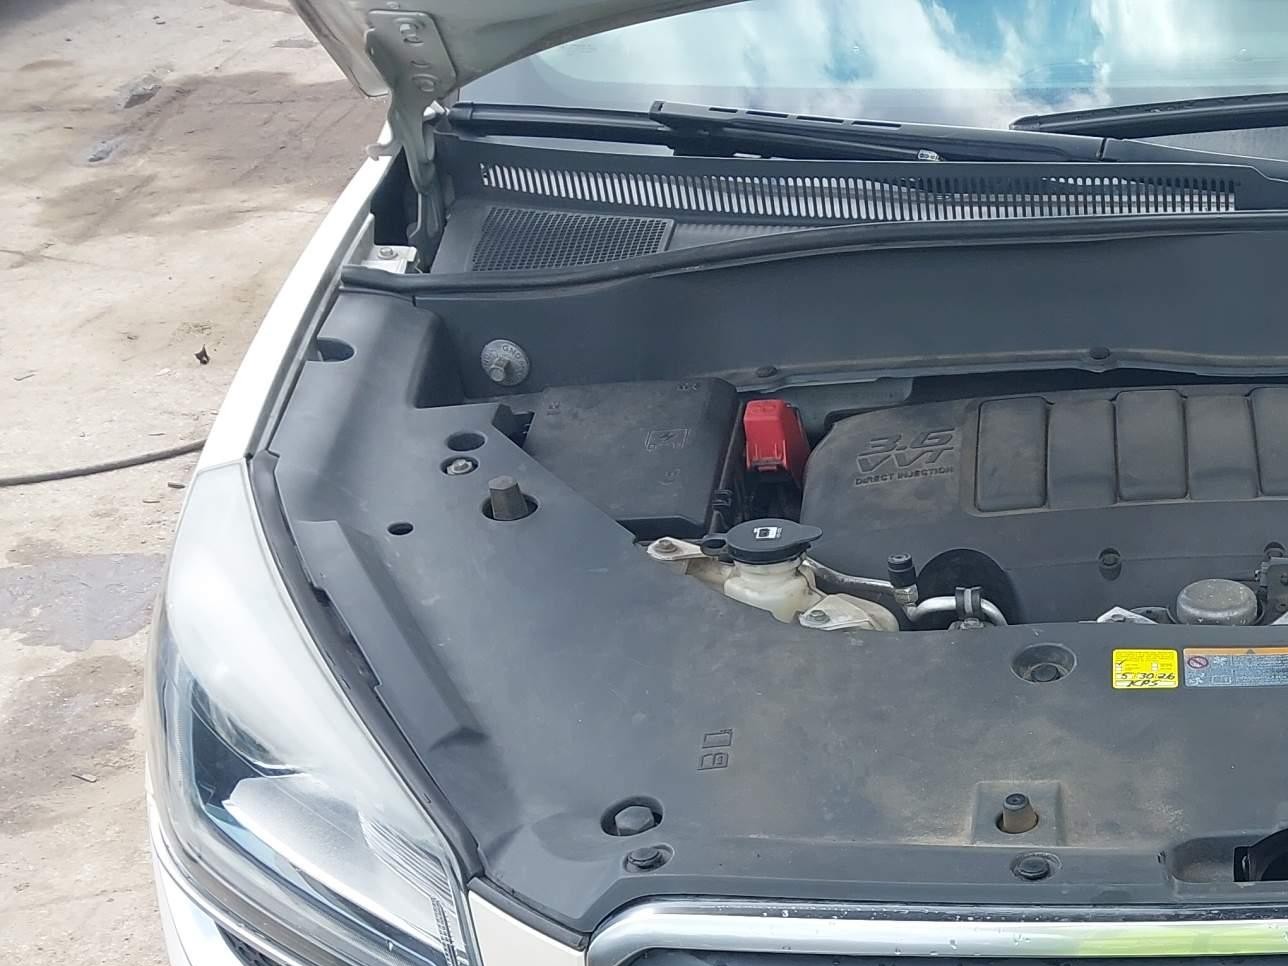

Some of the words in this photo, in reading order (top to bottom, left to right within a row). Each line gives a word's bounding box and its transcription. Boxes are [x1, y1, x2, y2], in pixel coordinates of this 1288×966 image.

[859, 428, 955, 457] 3.6
[856, 446, 954, 474] VVT
[855, 473, 895, 486] DIRECT
[897, 466, 955, 480] INJECTION
